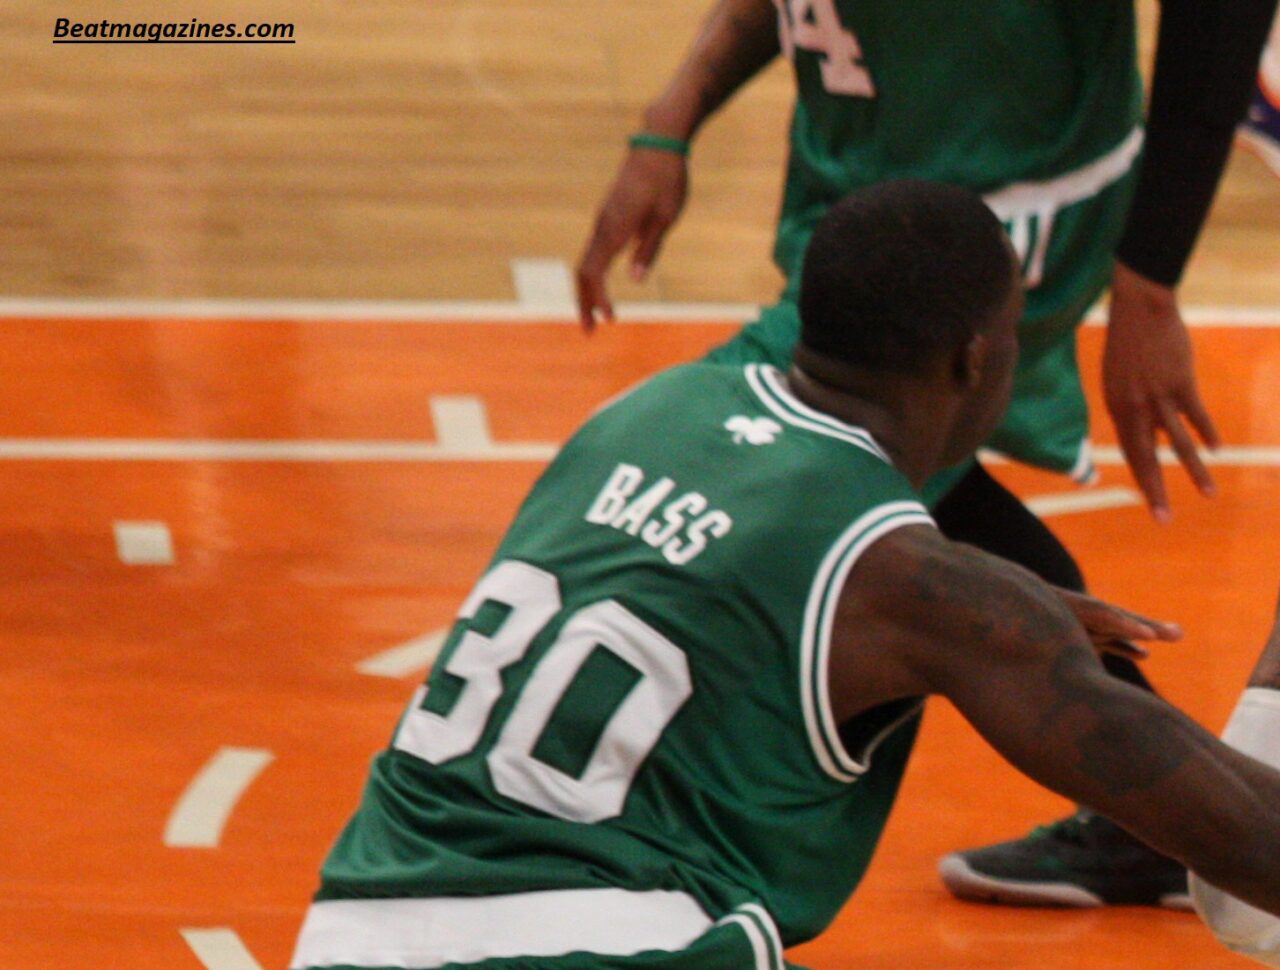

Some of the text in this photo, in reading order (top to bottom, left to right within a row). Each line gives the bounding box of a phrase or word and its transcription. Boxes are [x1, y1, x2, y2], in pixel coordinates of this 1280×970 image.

[770, 0, 877, 98] 4
[585, 462, 732, 566] BASS
[393, 558, 694, 825] 30
